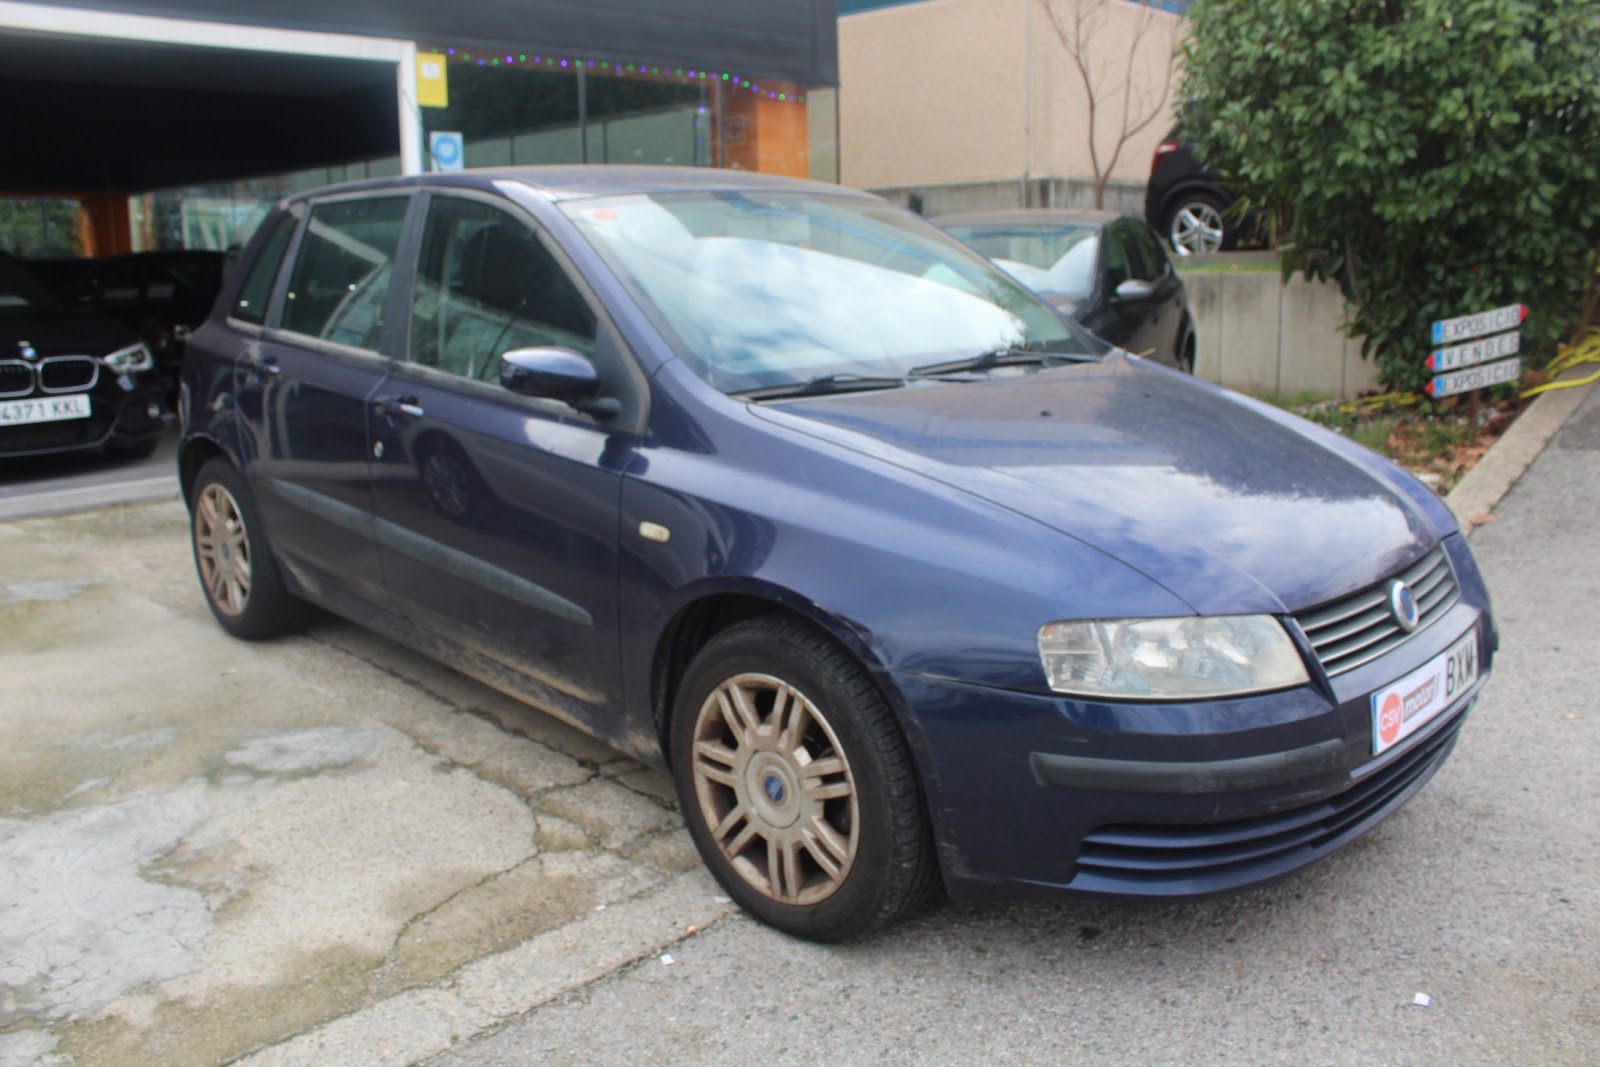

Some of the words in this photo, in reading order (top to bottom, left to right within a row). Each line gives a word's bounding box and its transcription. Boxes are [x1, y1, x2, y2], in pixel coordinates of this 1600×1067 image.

[1446, 336, 1518, 366] VENDES
[2, 402, 46, 421] 4371
[52, 399, 82, 416] KKL
